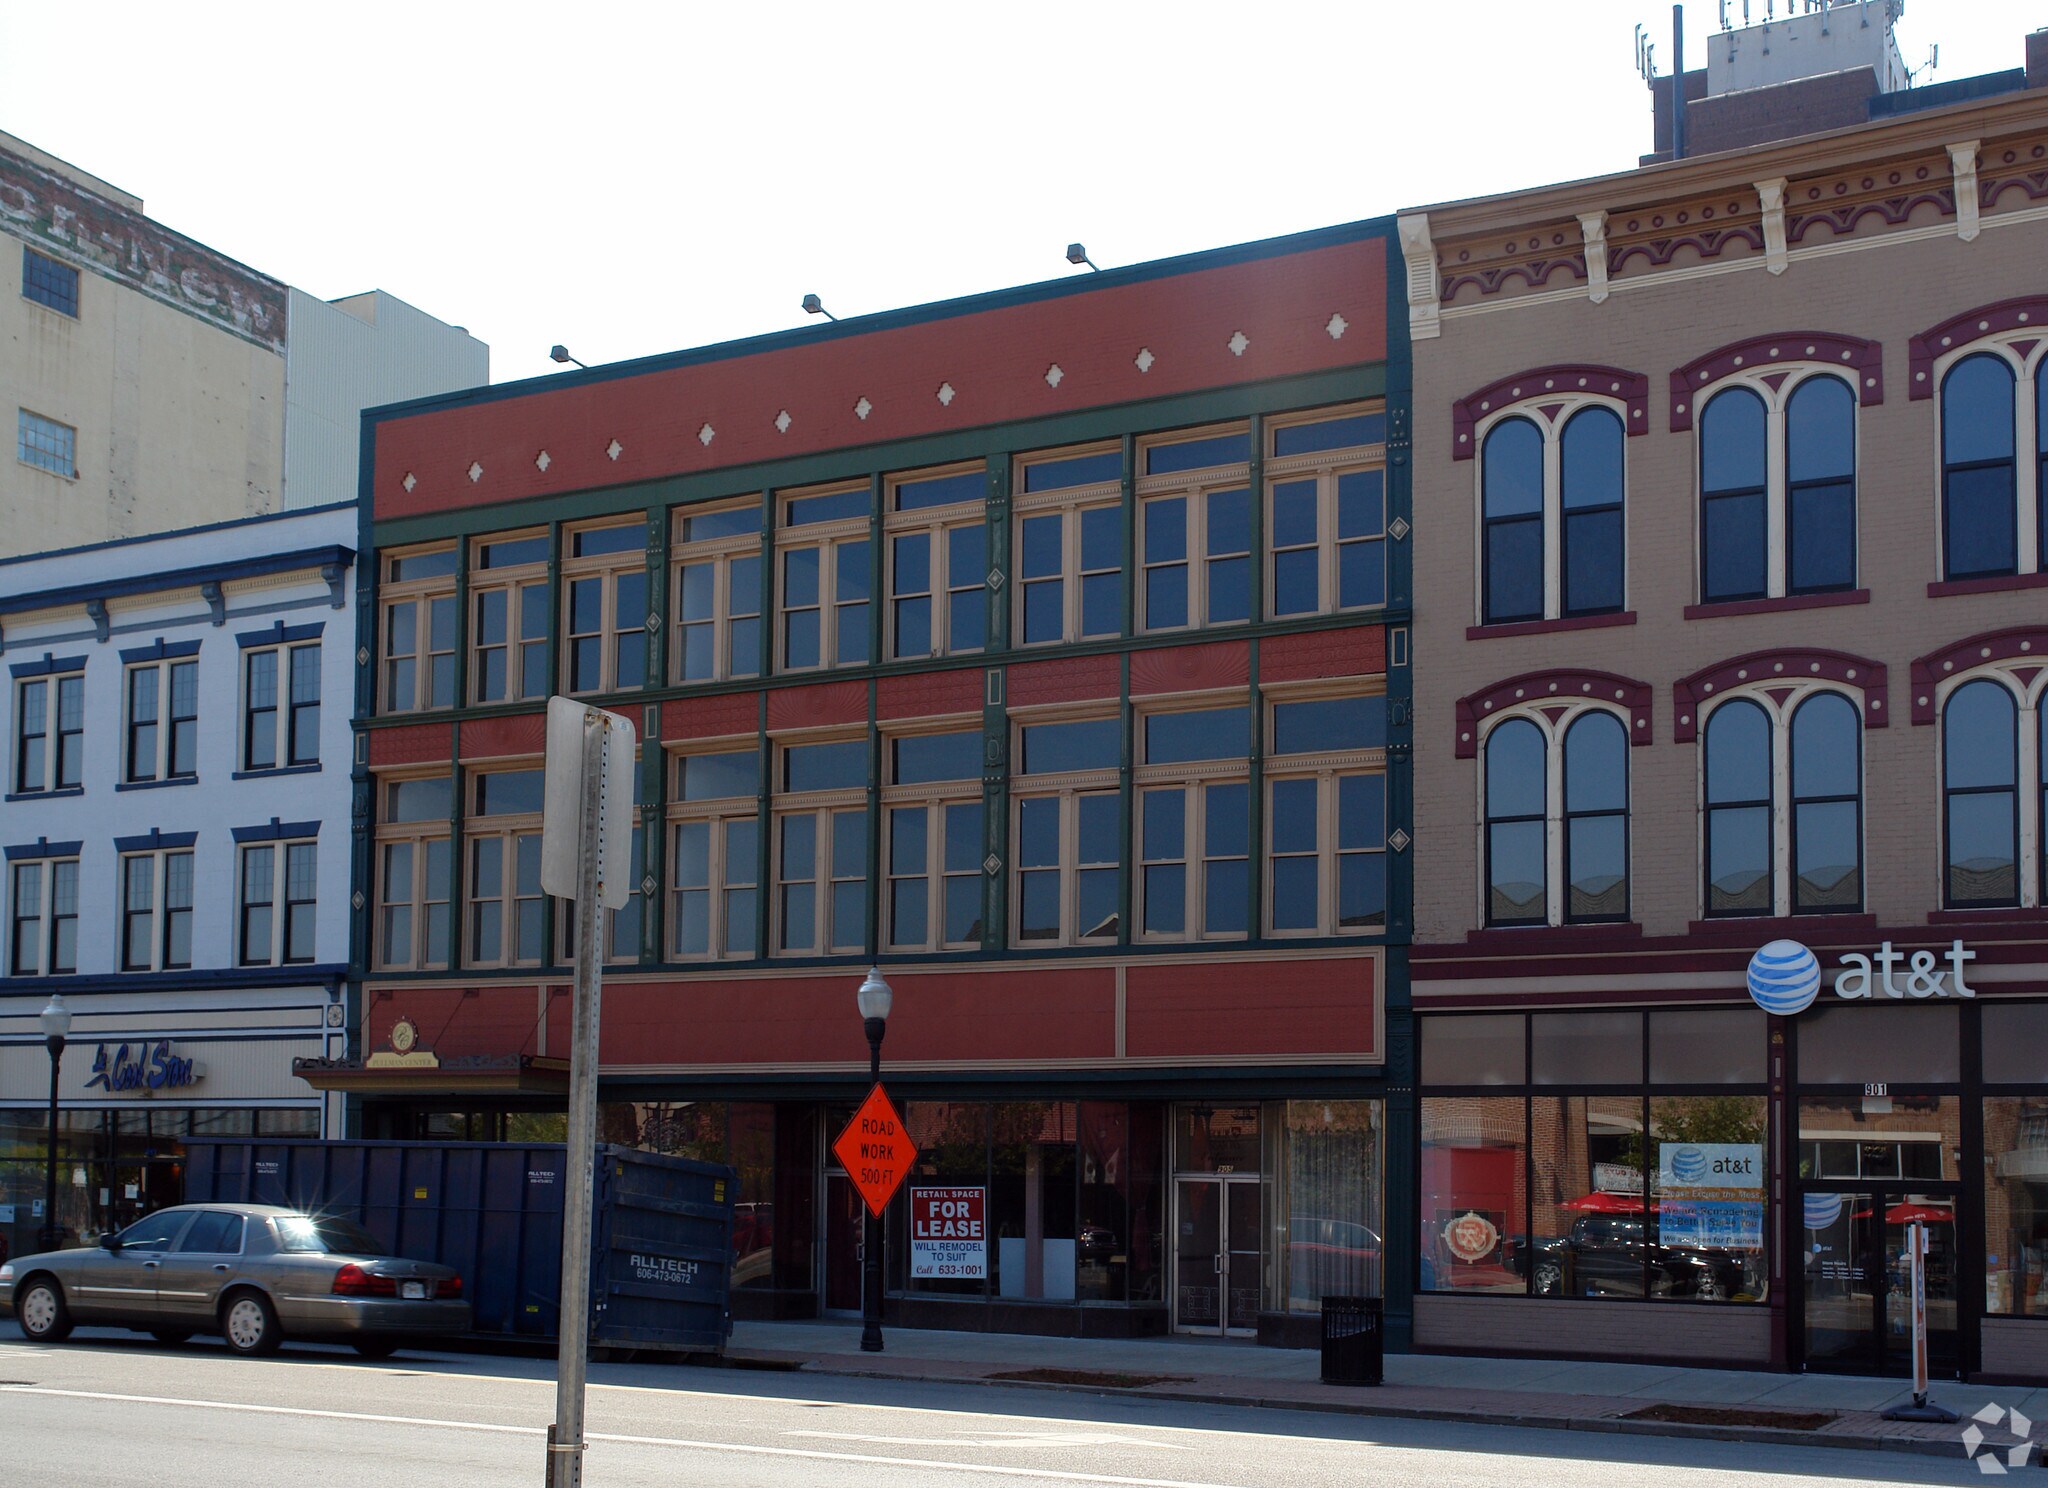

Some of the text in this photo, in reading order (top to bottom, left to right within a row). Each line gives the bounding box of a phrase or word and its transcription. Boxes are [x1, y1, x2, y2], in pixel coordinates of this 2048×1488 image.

[1834, 939, 1976, 999] at&t
[148, 1040, 193, 1089] Store
[1865, 1083, 1886, 1096] 901
[862, 1119, 894, 1136] ROAD
[861, 1143, 894, 1160] WORK
[1712, 1157, 1752, 1174] at&t
[861, 1168, 894, 1185] 500 FT
[1692, 1190, 1720, 1198] Excuse
[929, 1201, 970, 1218] FOR
[1700, 1207, 1759, 1218] Remodeling
[917, 1221, 982, 1237] LEASE
[915, 1242, 983, 1252] WILL REMODEL
[630, 1255, 698, 1274] ALLTECH
[932, 1253, 967, 1261] TO SUIT
[637, 1268, 691, 1284] 606-473-0672
[916, 1265, 982, 1275] Call 633-1001
